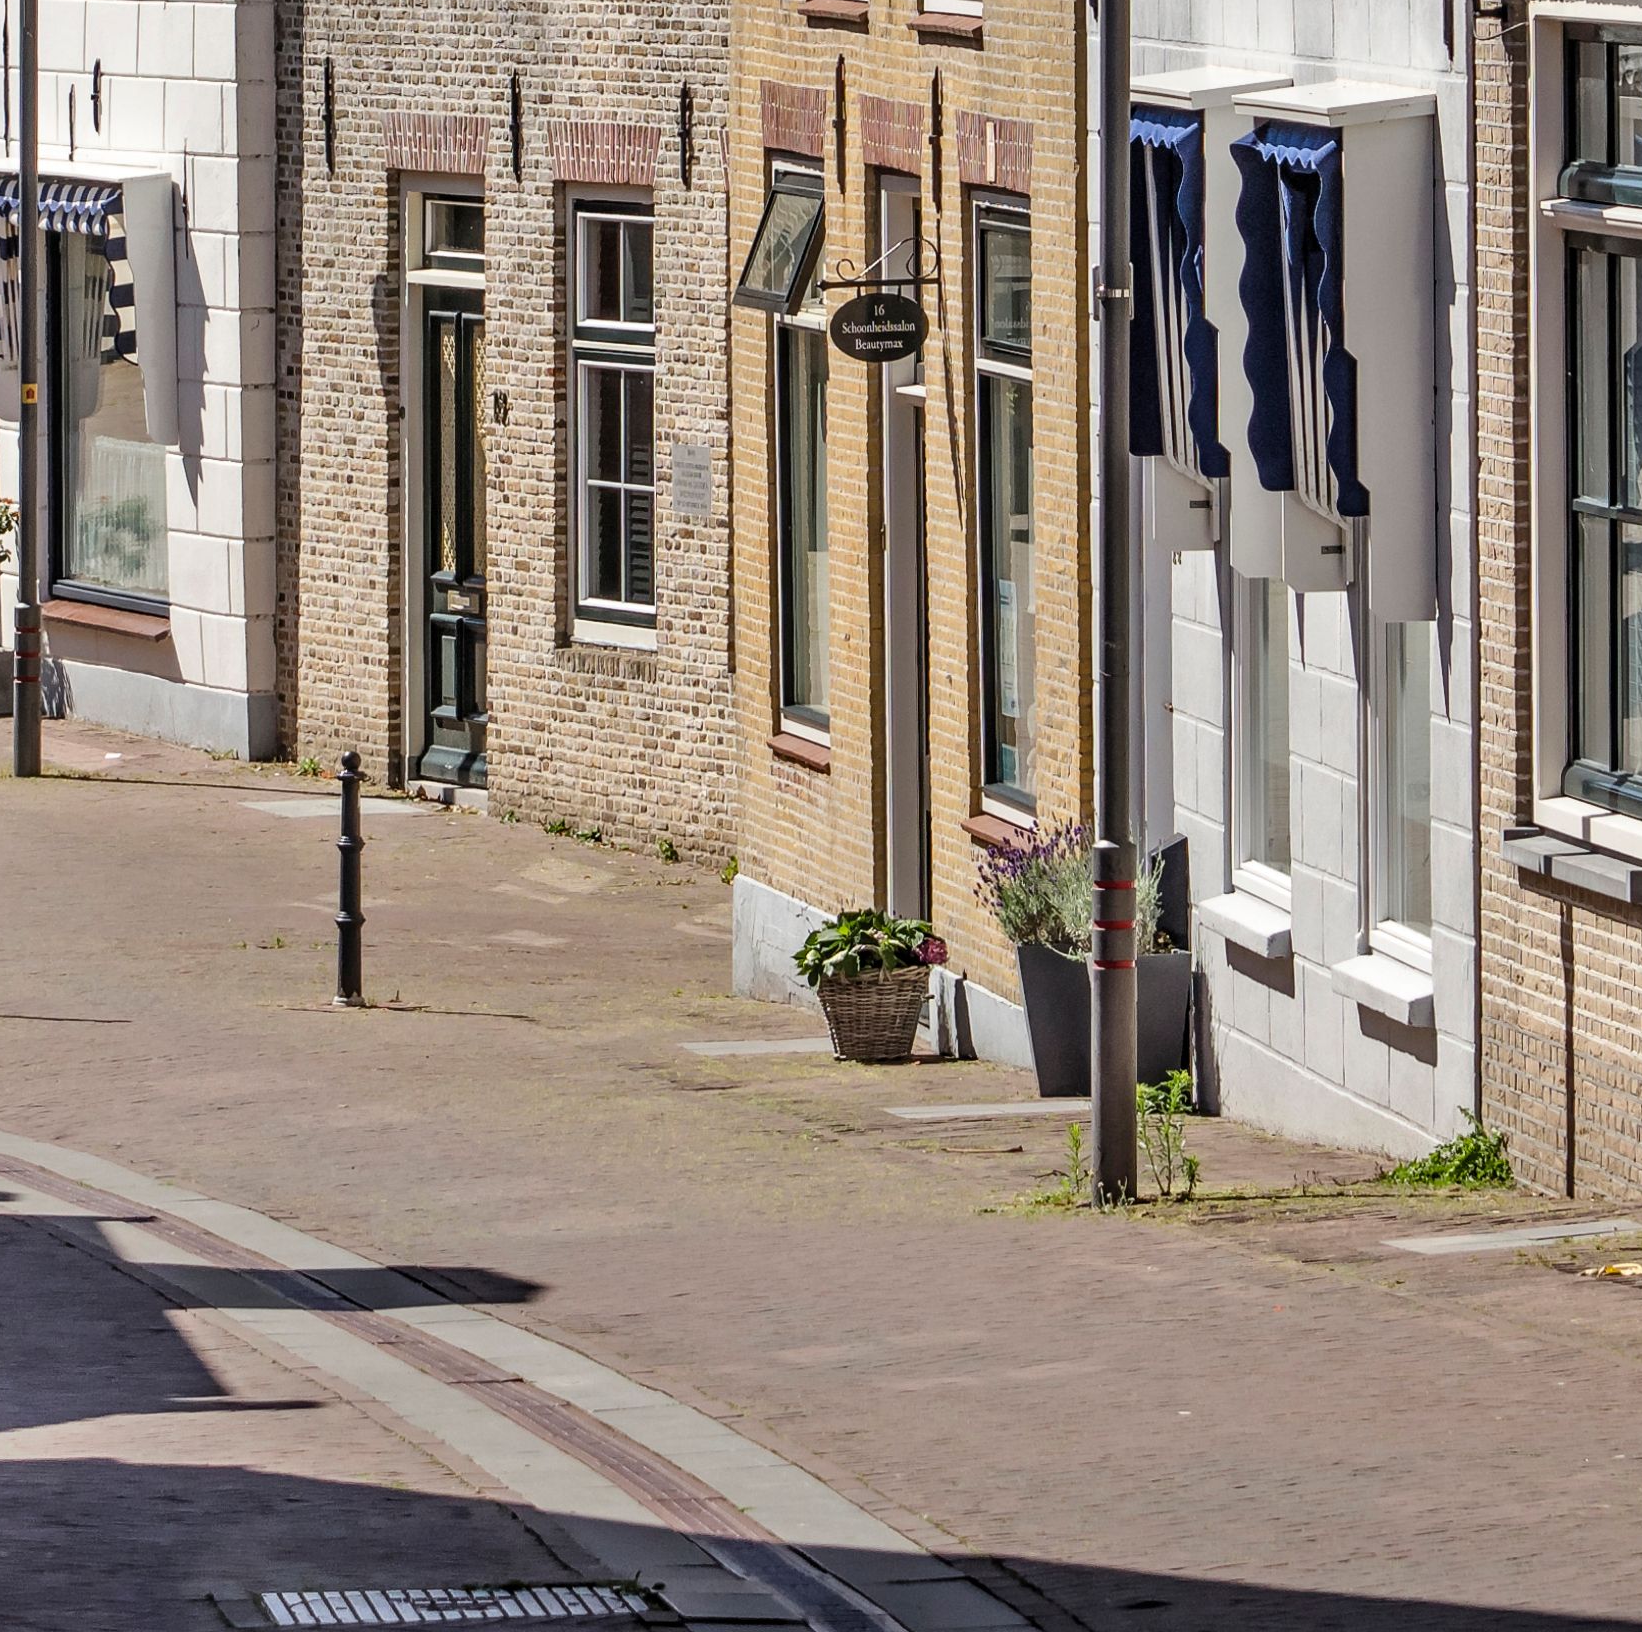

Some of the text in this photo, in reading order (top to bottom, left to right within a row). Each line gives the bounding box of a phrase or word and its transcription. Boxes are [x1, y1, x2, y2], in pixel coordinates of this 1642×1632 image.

[874, 304, 885, 316] 16
[841, 319, 916, 334] Schoonheidssalon
[855, 338, 903, 353] Beautymax
